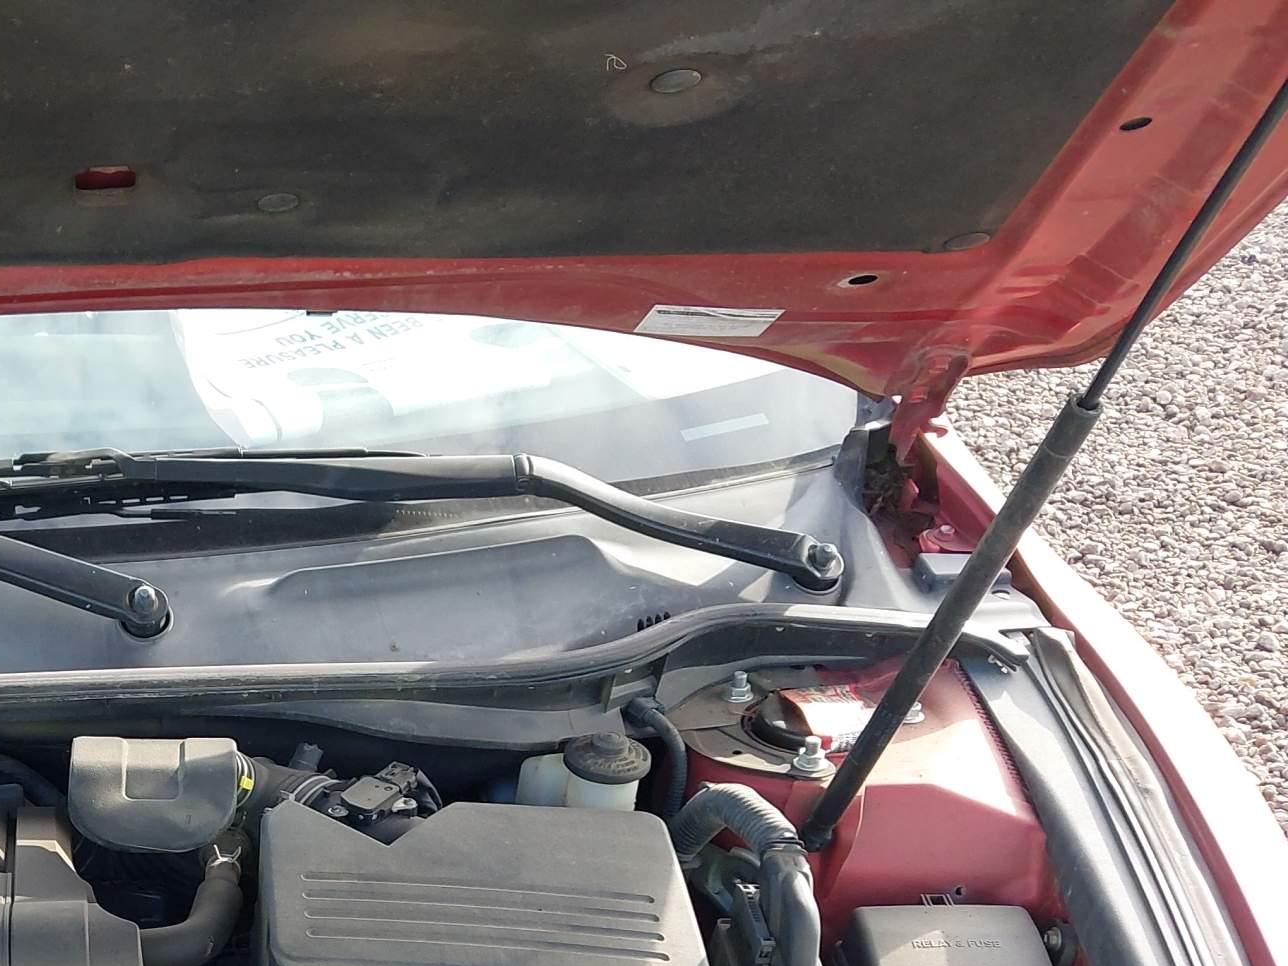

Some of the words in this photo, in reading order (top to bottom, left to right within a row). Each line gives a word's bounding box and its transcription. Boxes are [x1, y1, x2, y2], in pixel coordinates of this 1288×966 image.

[275, 329, 324, 347] YOU
[345, 334, 365, 345] A
[238, 338, 346, 369] PLEASURE
[912, 939, 952, 949] RELAY
[966, 939, 1002, 949] FUSE
